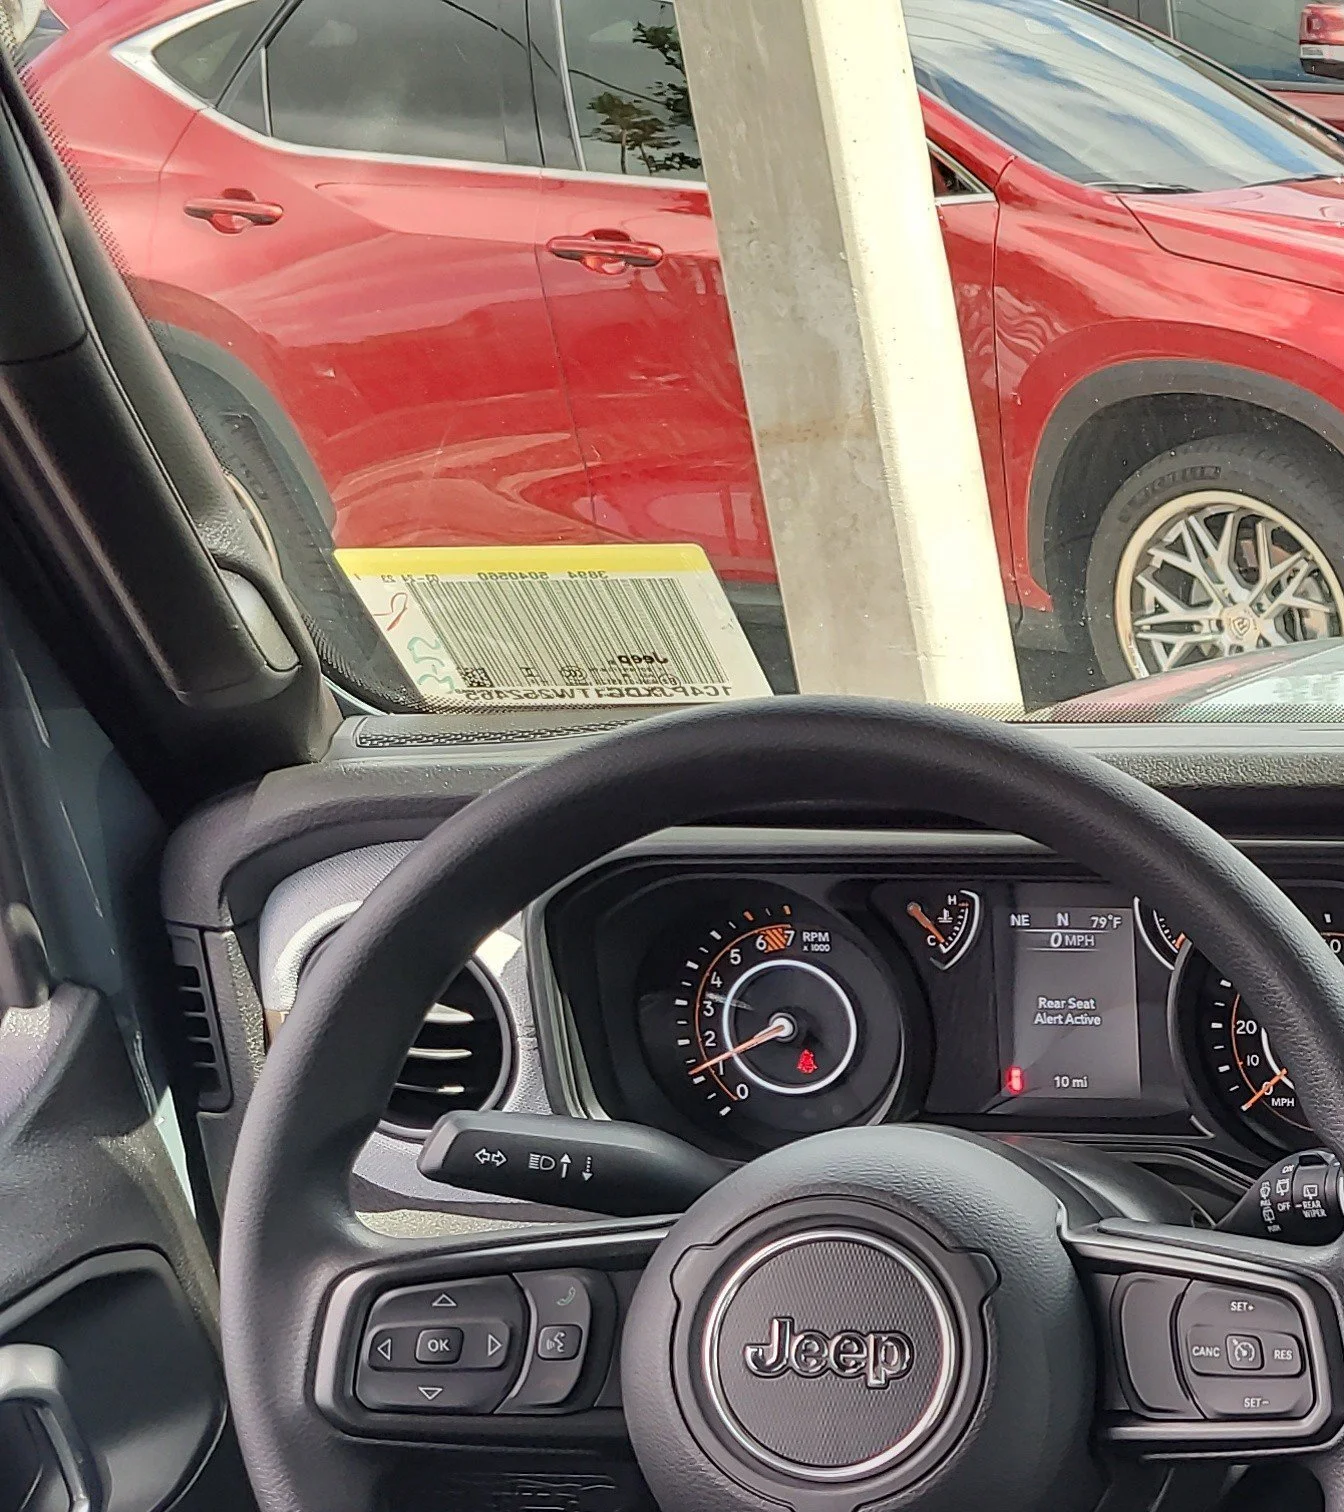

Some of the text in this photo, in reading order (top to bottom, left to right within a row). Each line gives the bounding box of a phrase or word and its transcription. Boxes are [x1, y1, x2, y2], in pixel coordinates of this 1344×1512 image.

[948, 895, 957, 905] H
[1010, 914, 1030, 926] NE
[1057, 913, 1069, 926] N
[756, 935, 766, 951] 6
[785, 930, 796, 946] 7
[803, 931, 830, 942] RPM
[927, 935, 936, 946] C
[1065, 934, 1095, 946] MPH
[730, 949, 742, 965] 5
[711, 972, 723, 987] 4
[703, 1000, 714, 1016] 3
[1038, 997, 1096, 1010] Rear Seat
[1034, 1012, 1101, 1026] Alert Active
[1236, 1020, 1257, 1035] 20
[704, 1031, 716, 1047] 2
[1246, 1055, 1259, 1066] 10
[1053, 1076, 1088, 1089] 10 mi
[736, 1083, 749, 1099] 0
[1271, 1097, 1295, 1107] MPH
[1277, 1201, 1291, 1212] OFF
[1302, 1200, 1322, 1209] REAR
[1302, 1209, 1327, 1218] WIPER
[427, 1338, 451, 1353] OK
[1192, 1345, 1220, 1358] CANC
[745, 1317, 915, 1389] Jeep
[1273, 1349, 1293, 1360] RES
